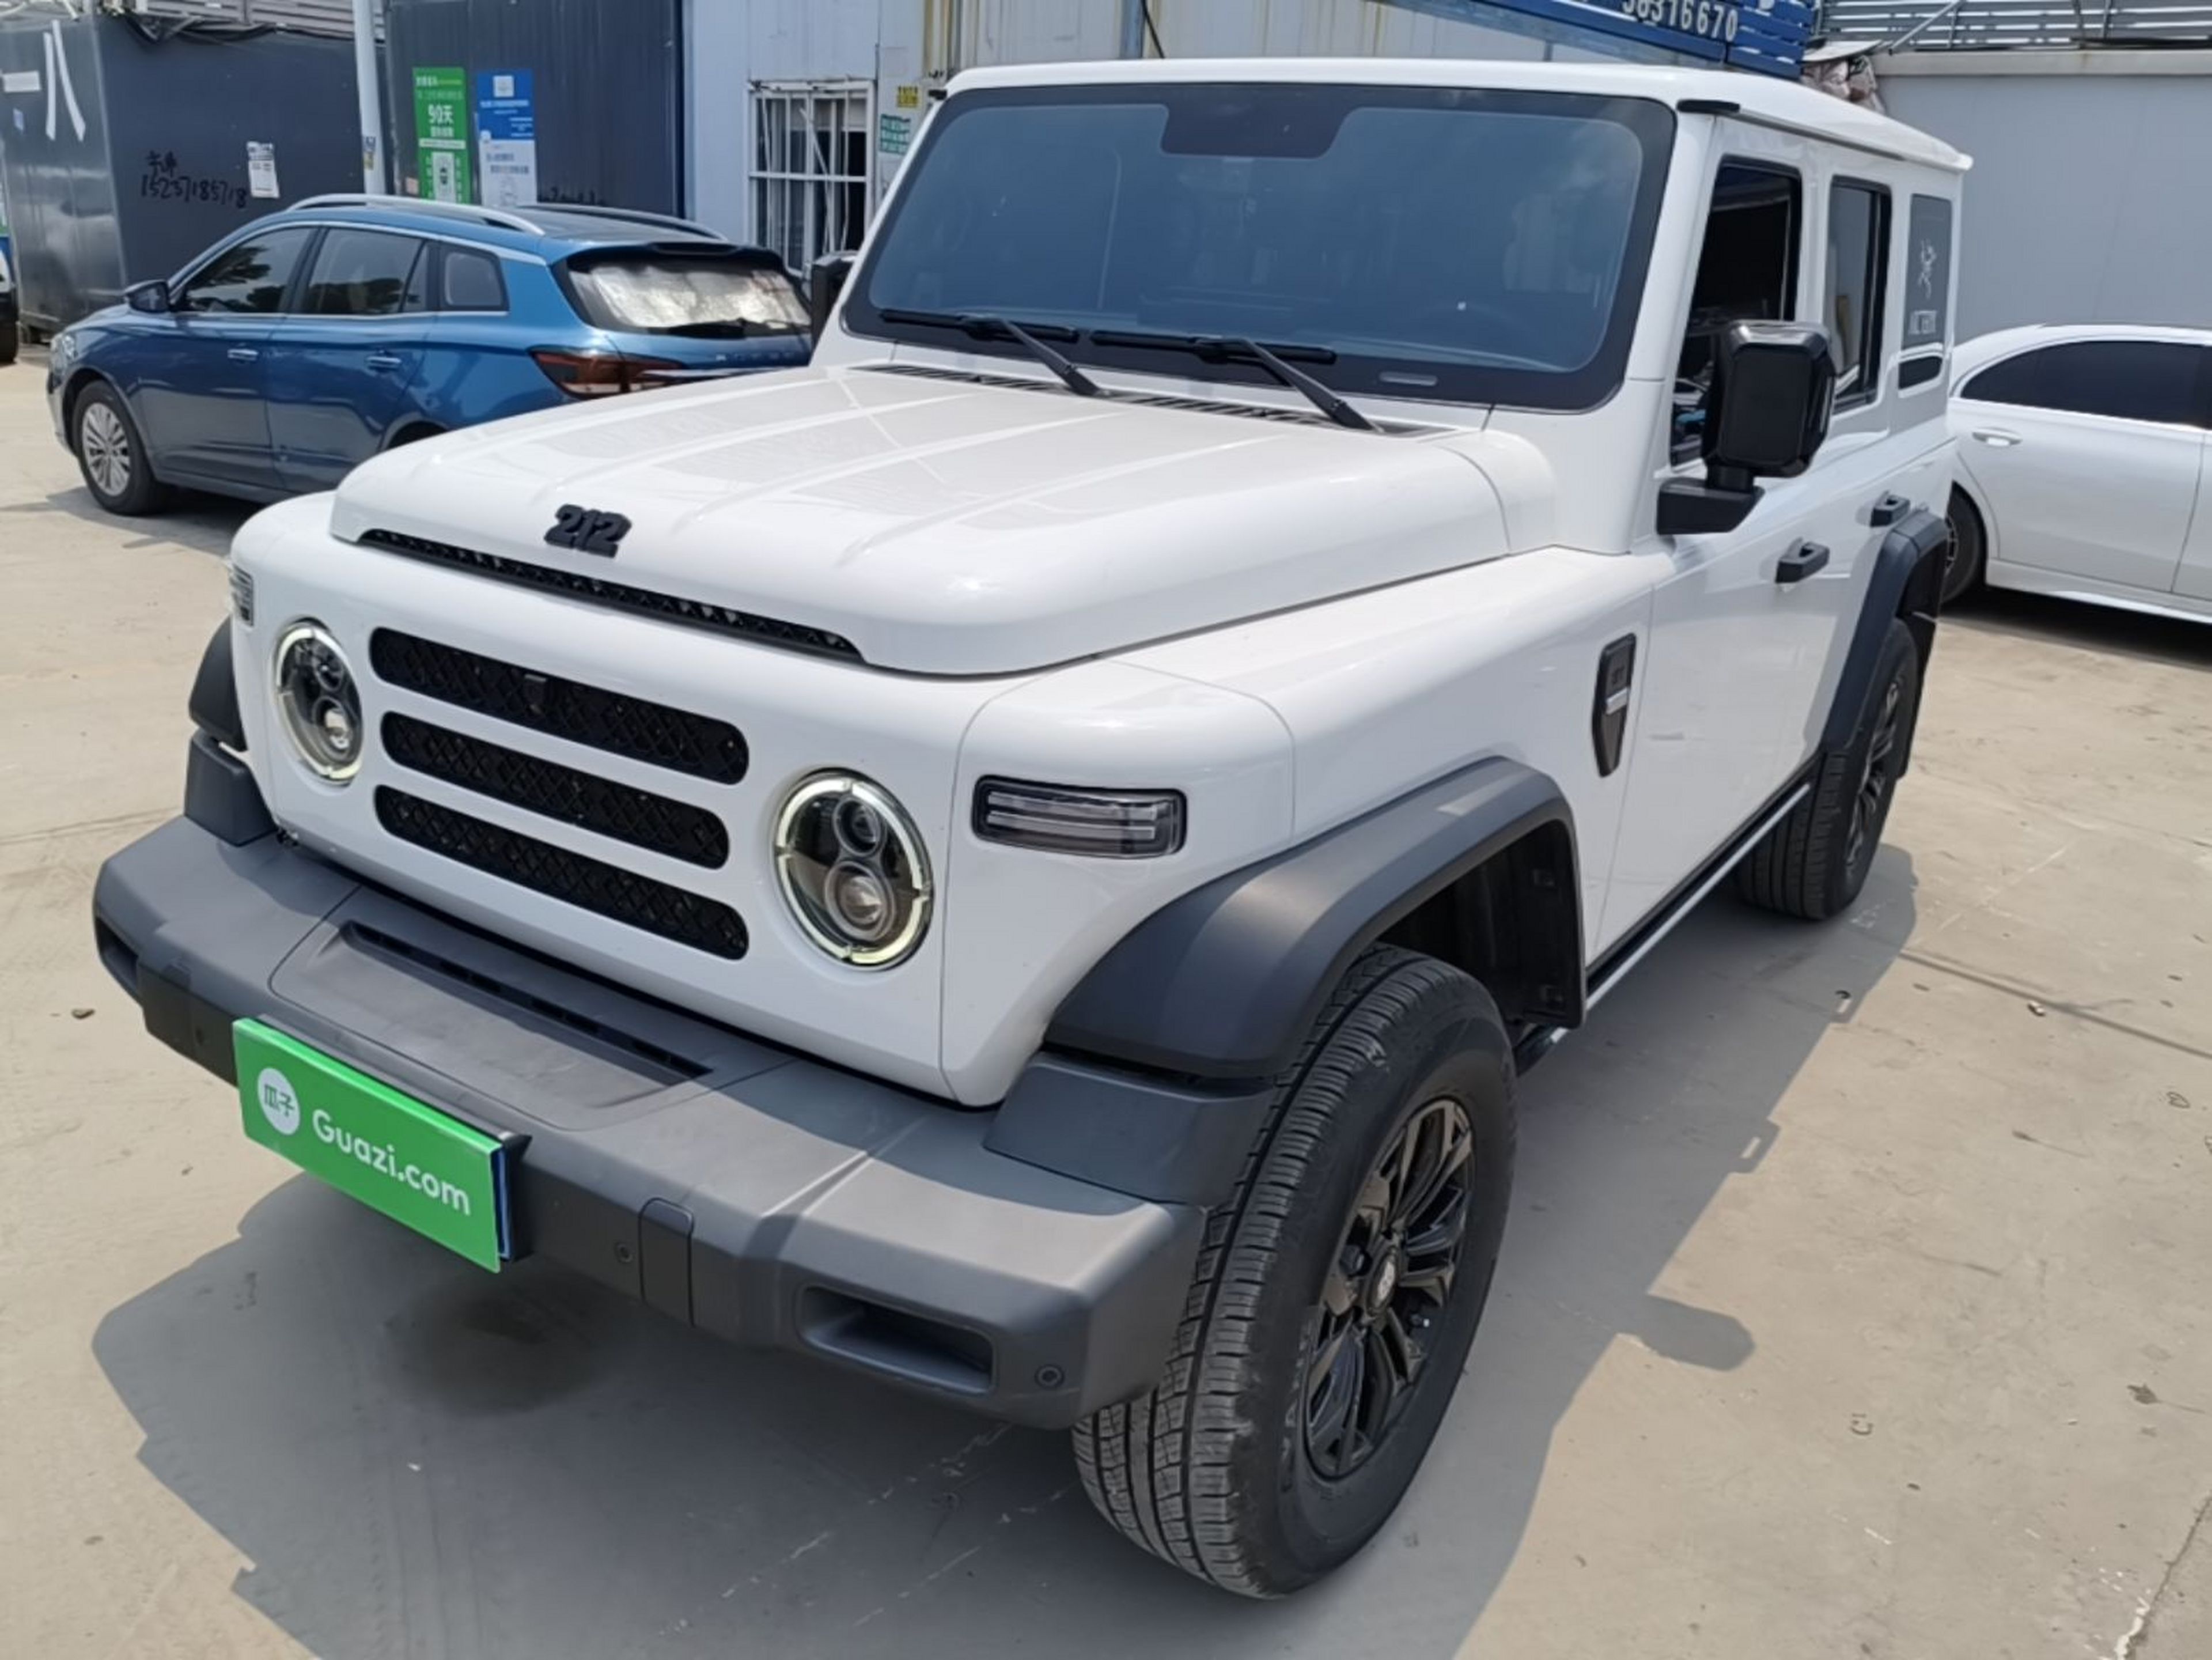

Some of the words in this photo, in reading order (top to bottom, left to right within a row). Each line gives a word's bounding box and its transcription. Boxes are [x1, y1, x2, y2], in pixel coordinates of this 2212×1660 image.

[544, 504, 632, 559] 212
[264, 1083, 296, 1117] 瓜子
[312, 1109, 470, 1215] Guazi.com
